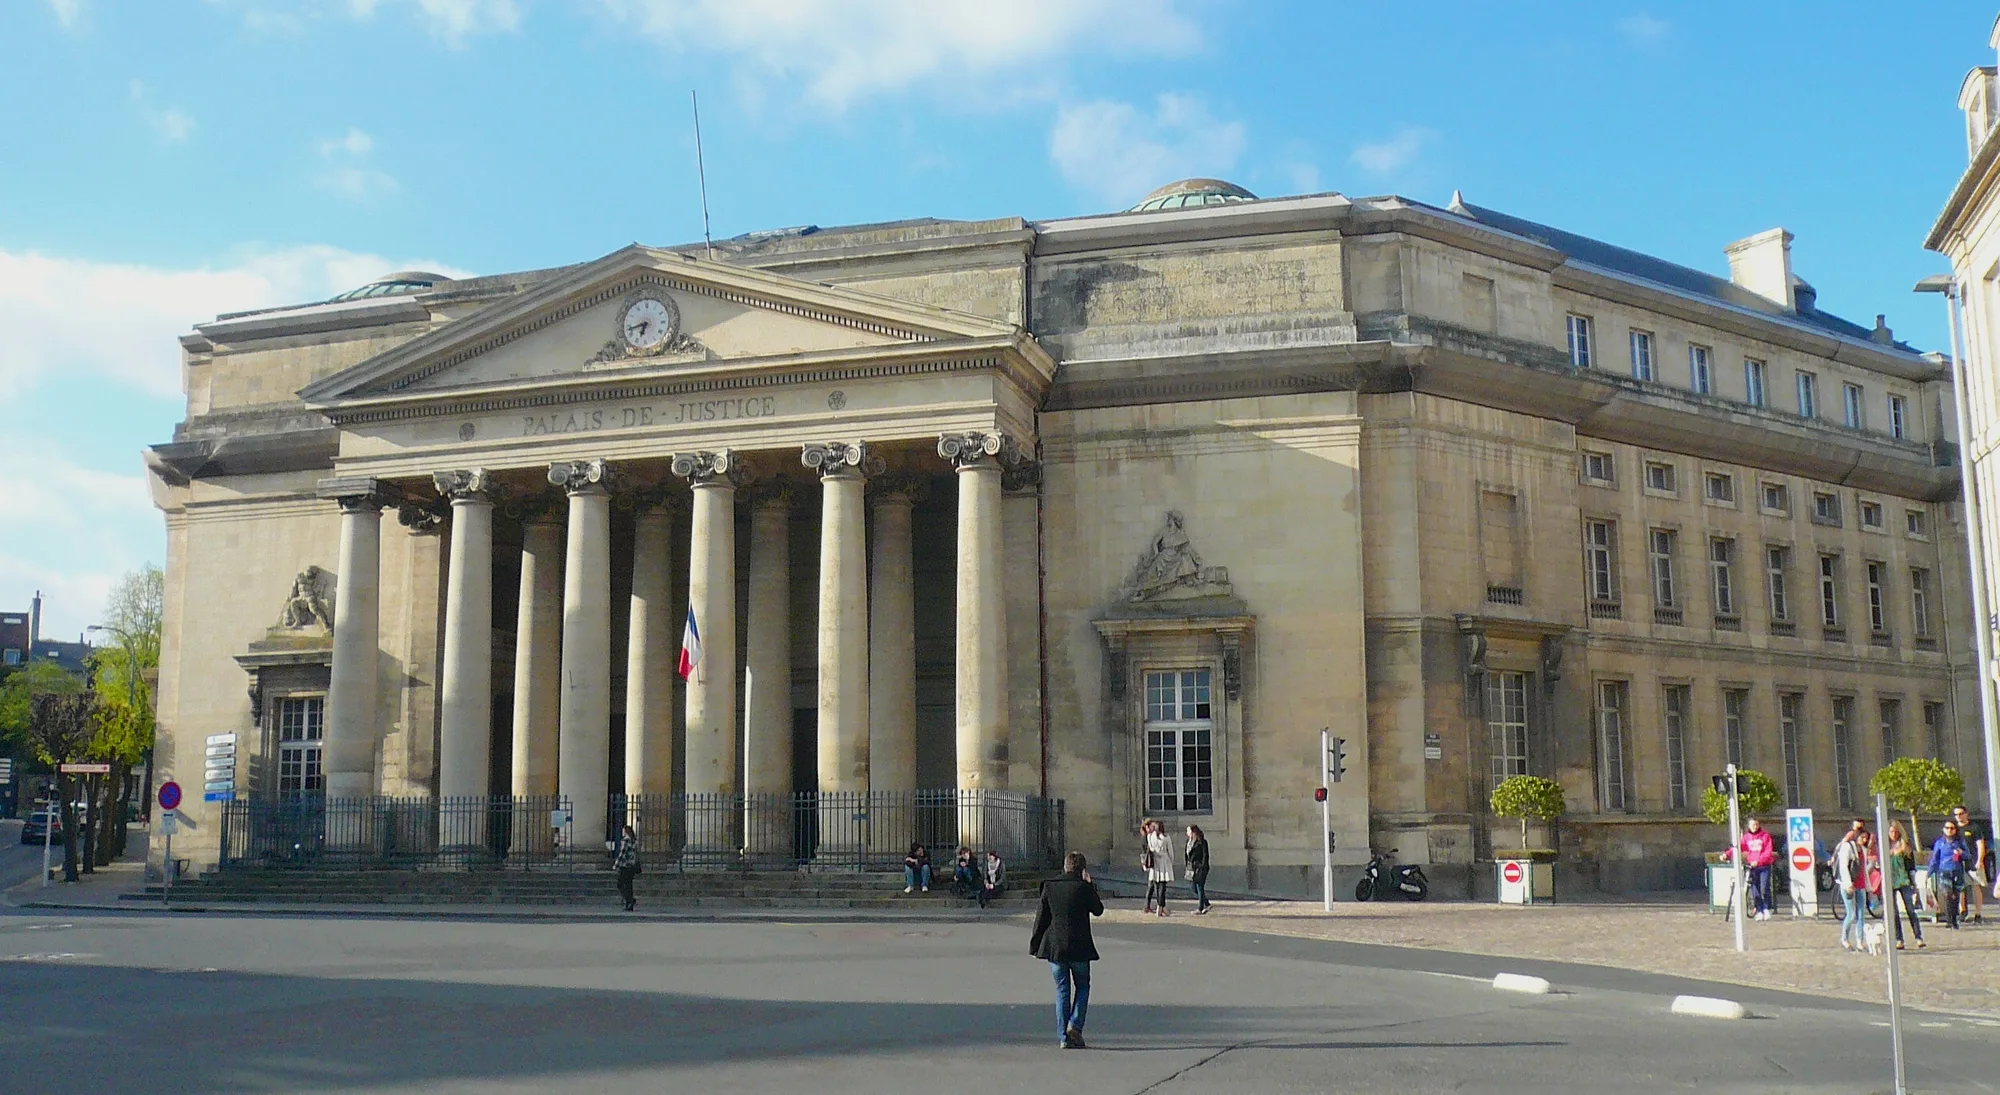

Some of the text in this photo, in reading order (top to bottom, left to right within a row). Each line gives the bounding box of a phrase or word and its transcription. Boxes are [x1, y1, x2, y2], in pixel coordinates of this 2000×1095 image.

[523, 396, 776, 436] PALAIS DE JUSTICE
